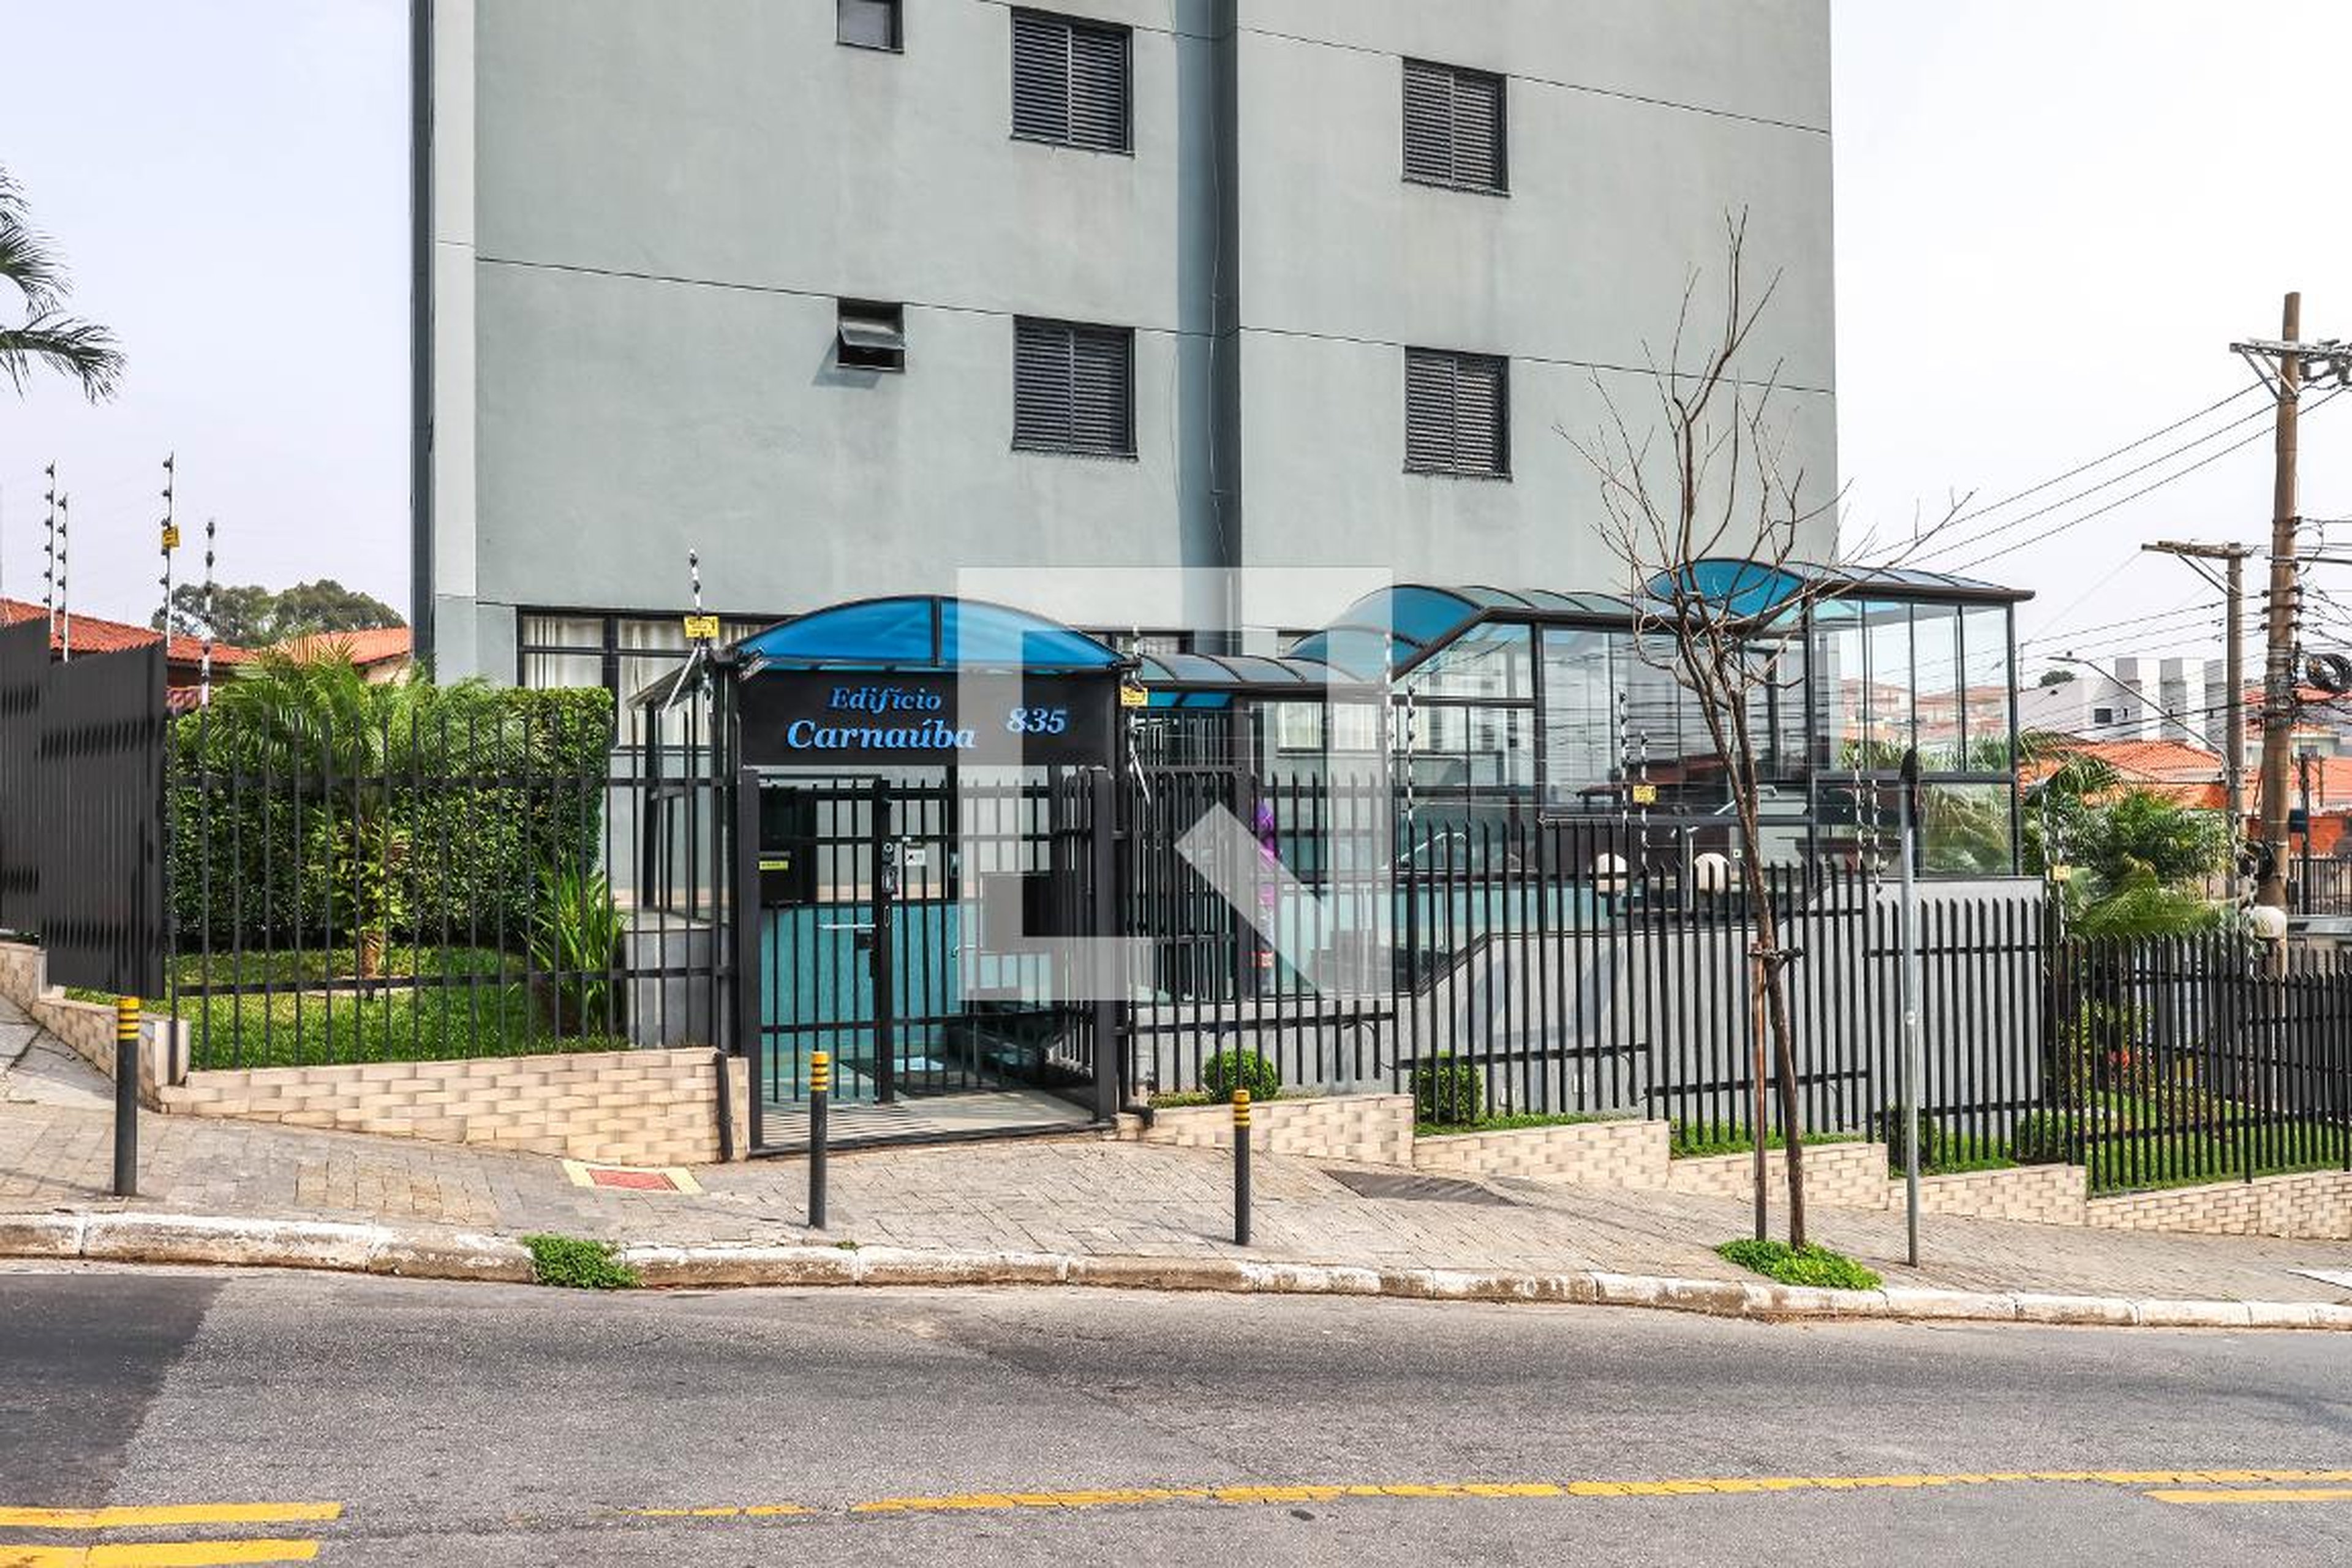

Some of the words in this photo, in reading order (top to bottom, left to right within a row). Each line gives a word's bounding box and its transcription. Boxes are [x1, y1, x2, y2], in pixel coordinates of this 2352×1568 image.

[828, 687, 941, 714] Edifício
[788, 718, 977, 748] Carnaúba
[1006, 707, 1067, 733] 835
